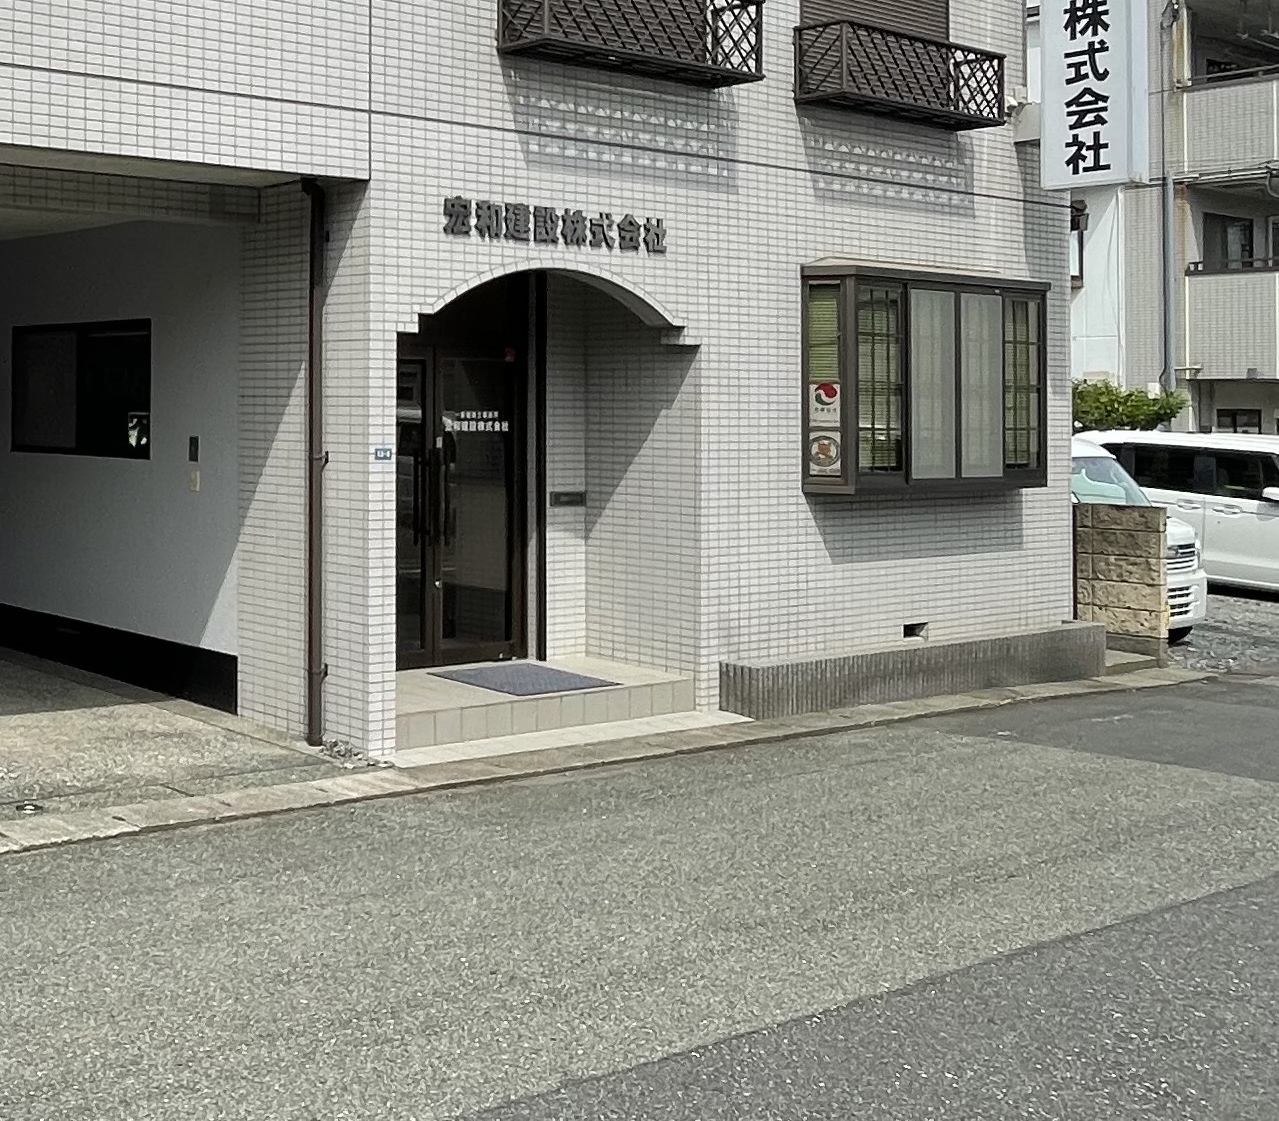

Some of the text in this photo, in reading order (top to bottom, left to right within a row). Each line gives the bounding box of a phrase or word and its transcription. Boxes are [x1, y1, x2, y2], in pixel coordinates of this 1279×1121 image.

[443, 195, 667, 254] 宏和建設株式会社
